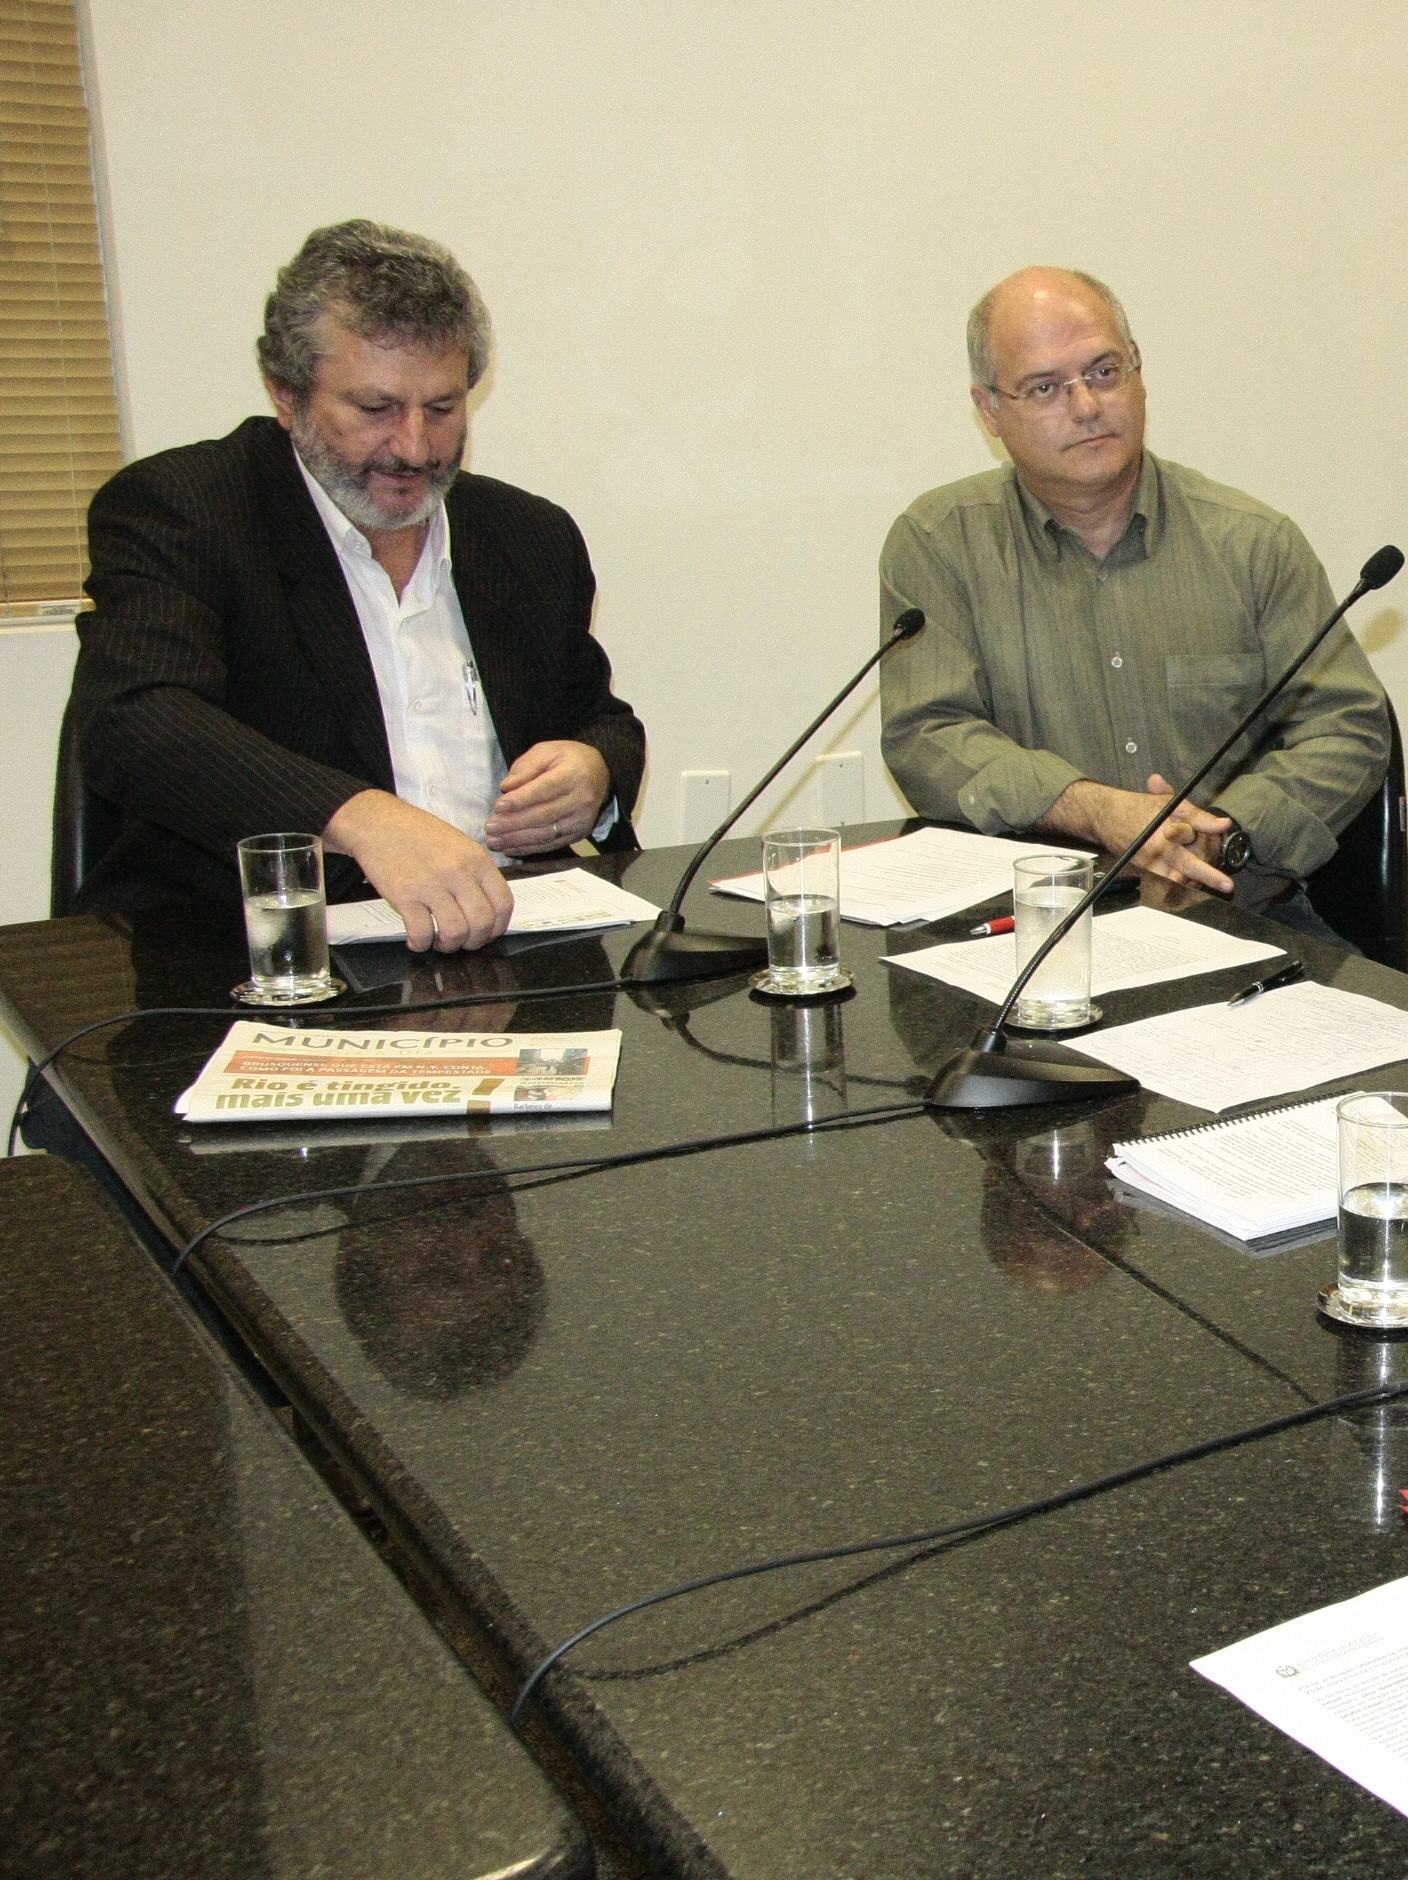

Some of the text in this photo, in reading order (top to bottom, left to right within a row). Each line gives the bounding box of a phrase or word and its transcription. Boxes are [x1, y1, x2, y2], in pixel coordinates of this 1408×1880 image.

[252, 1032, 513, 1051] MUNICÍPIO
[231, 1077, 289, 1091] Rio
[296, 1079, 318, 1091] é
[215, 1091, 305, 1110] mais
[312, 1091, 392, 1107] uma
[401, 1089, 462, 1105] vez
